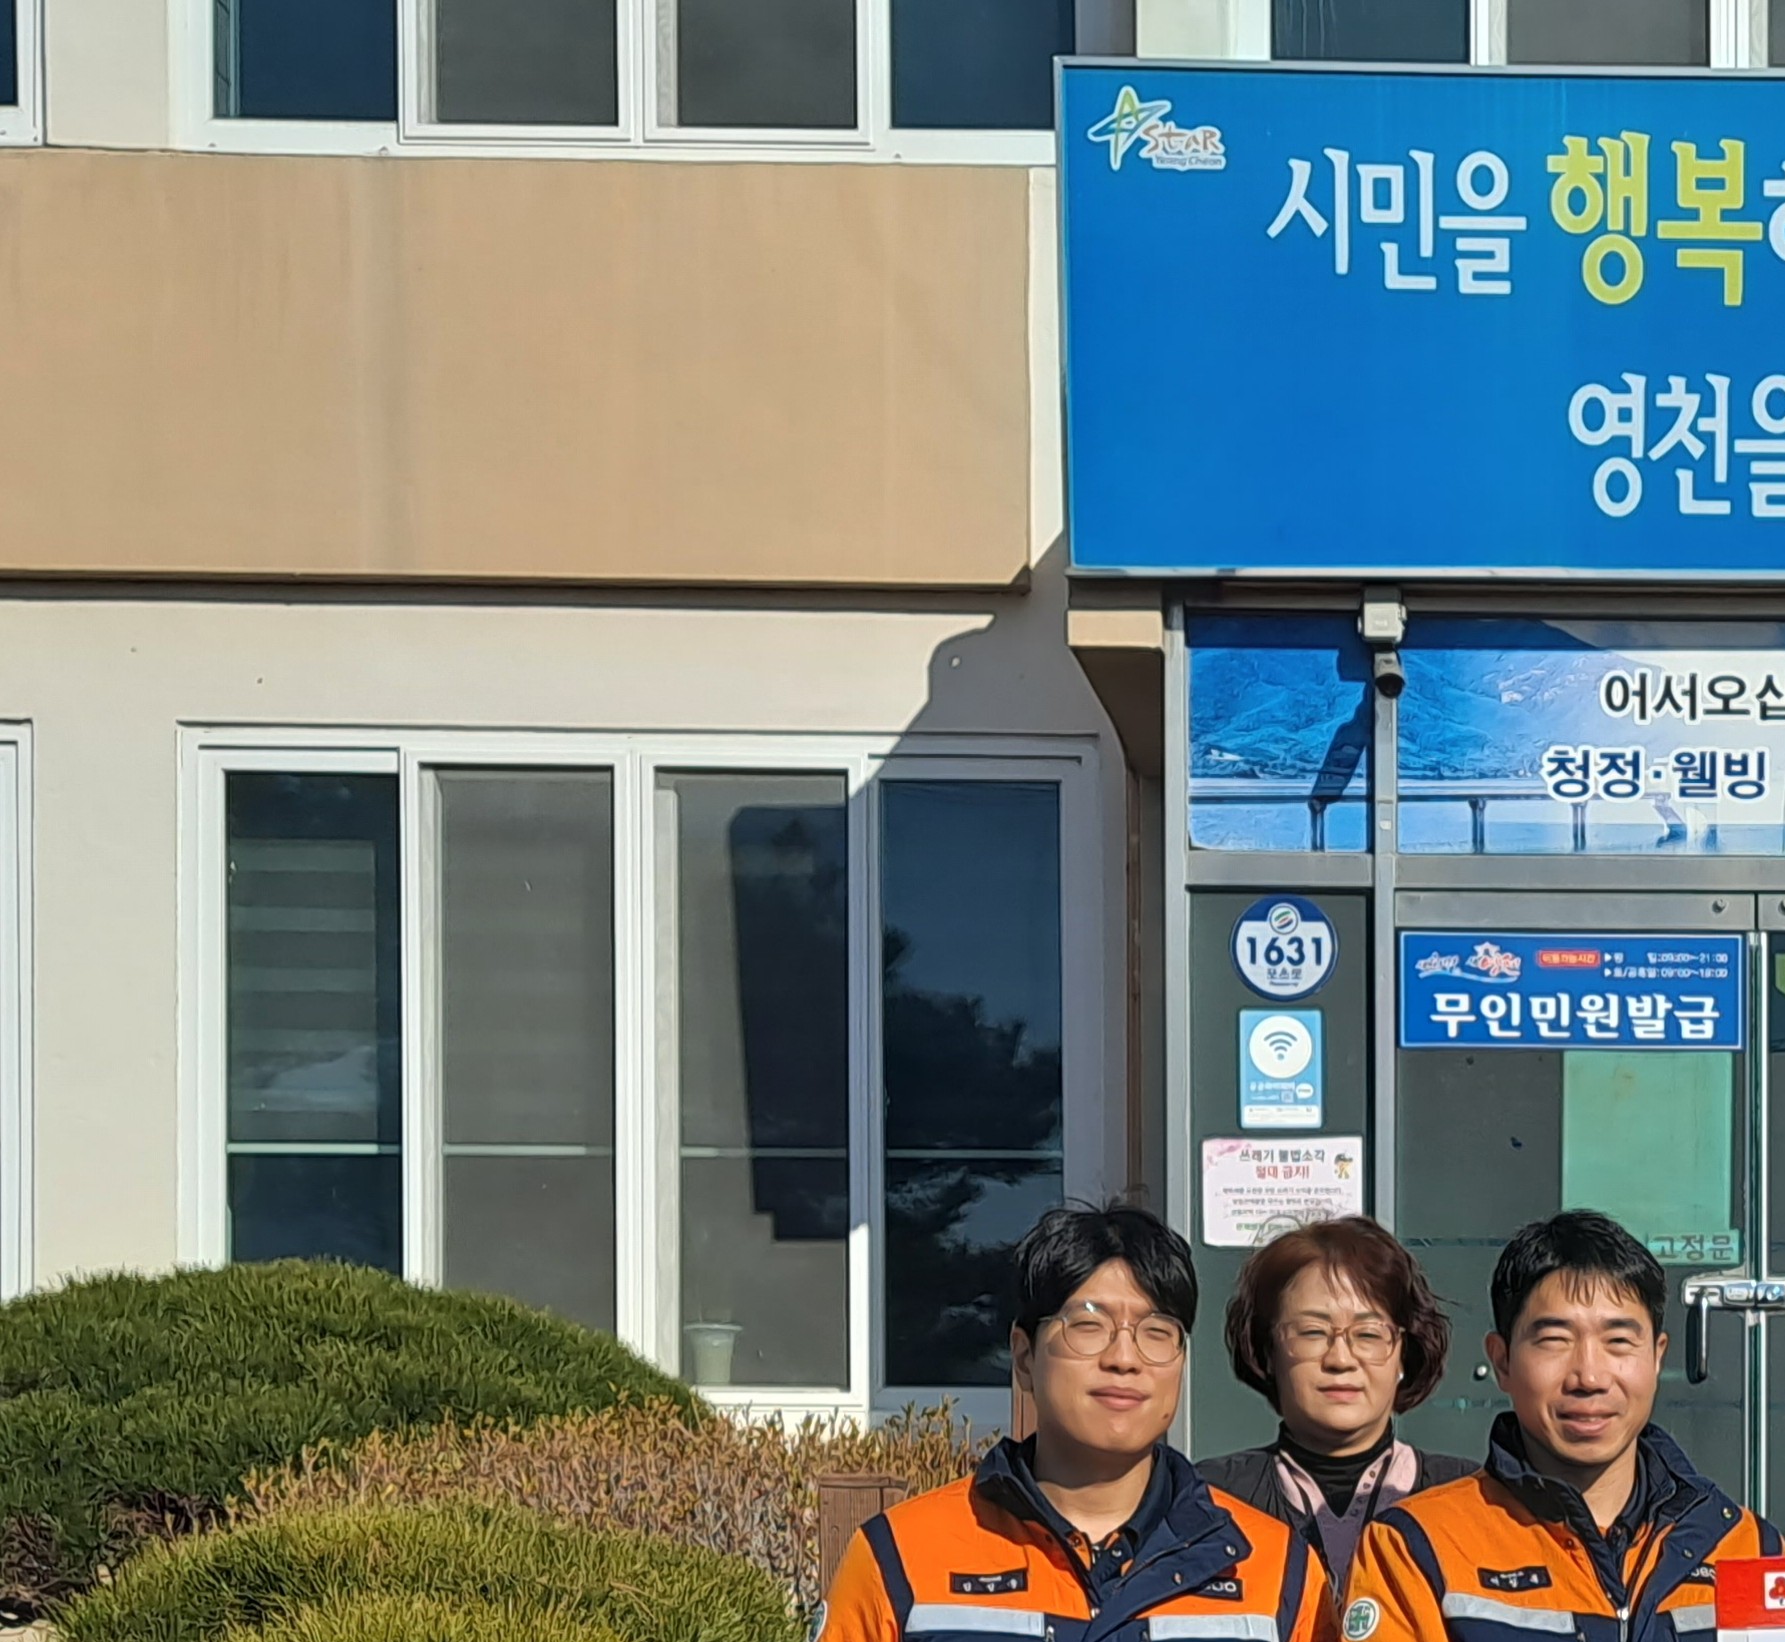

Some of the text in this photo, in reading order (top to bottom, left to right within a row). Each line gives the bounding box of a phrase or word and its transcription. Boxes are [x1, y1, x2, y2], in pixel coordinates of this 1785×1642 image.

[1267, 147, 1527, 294] 시민을
[1246, 935, 1322, 967] 1631
[1429, 991, 1721, 1040] 무인민원발급
[1239, 1148, 1275, 1162] 쓰레기
[1652, 1233, 1735, 1262] 고정문
